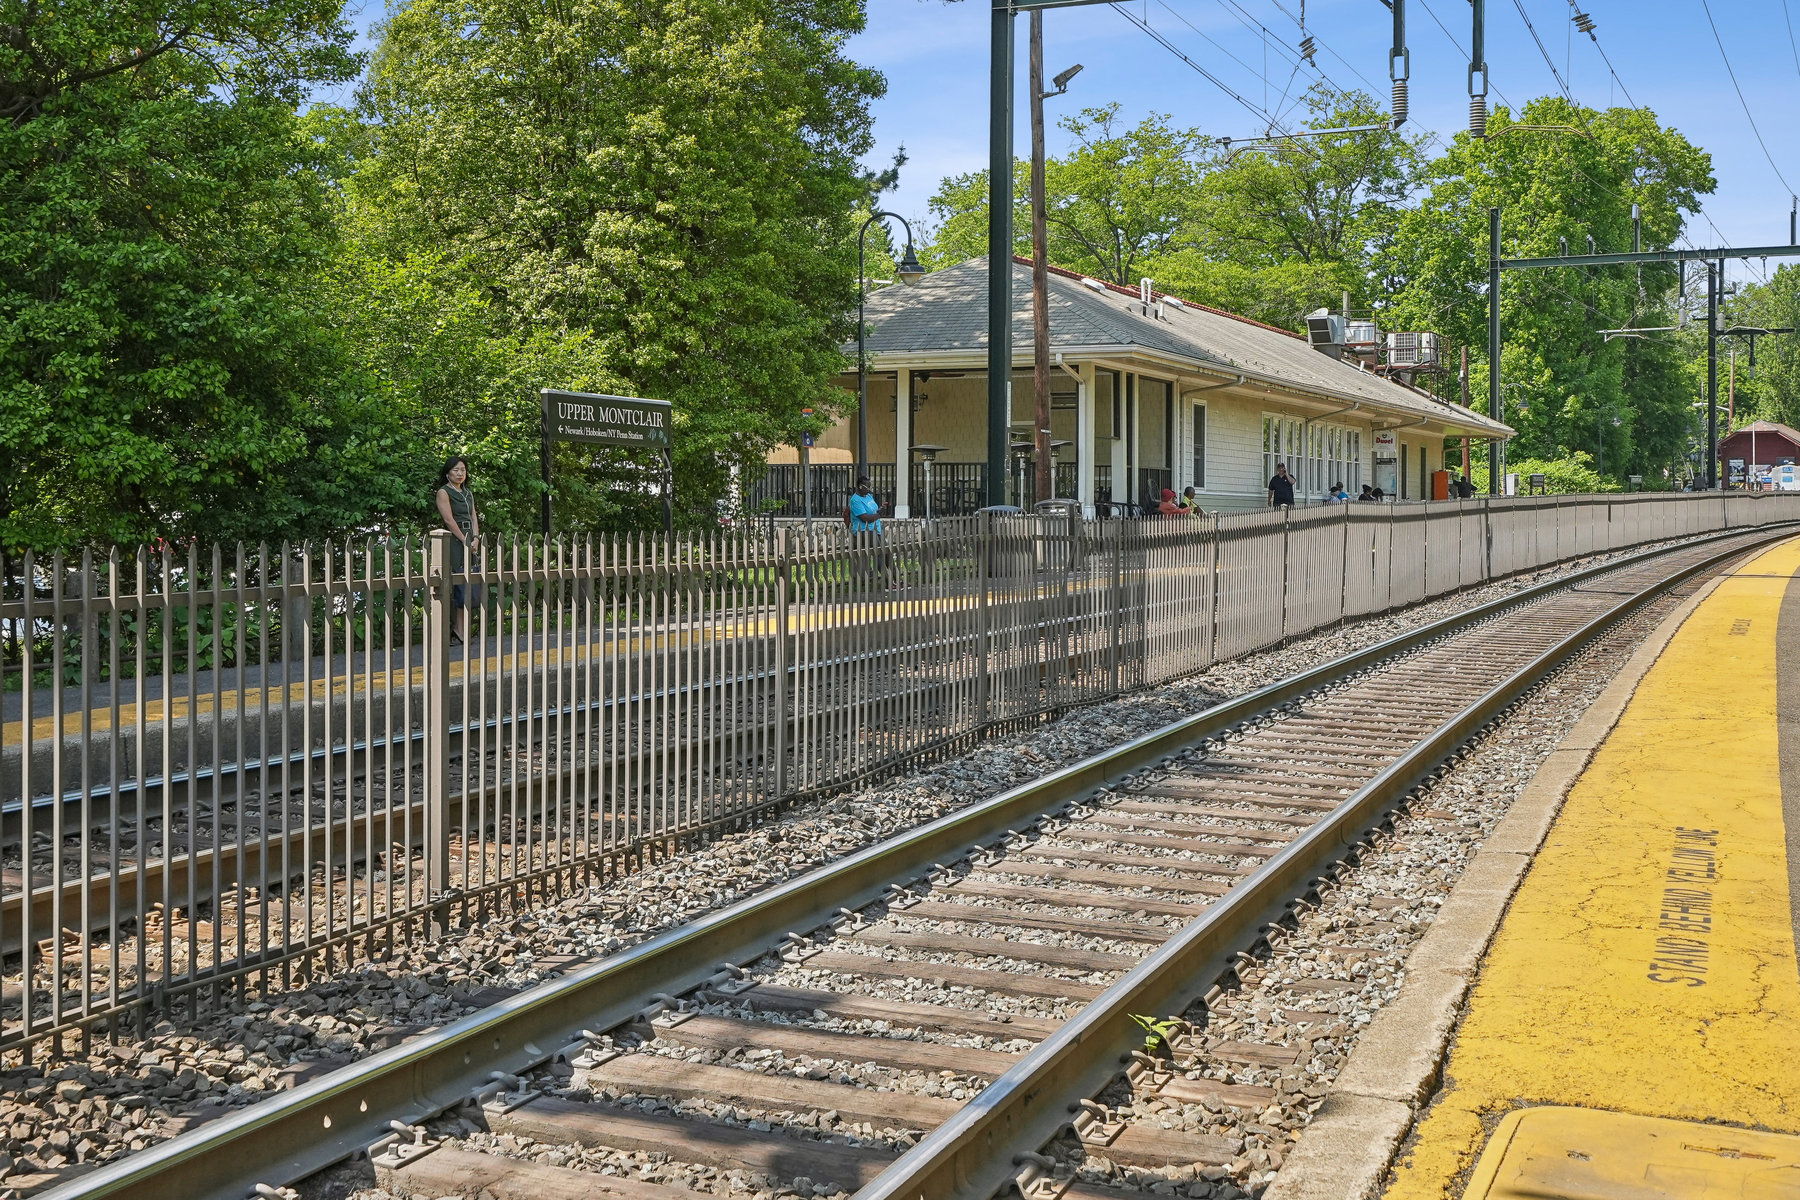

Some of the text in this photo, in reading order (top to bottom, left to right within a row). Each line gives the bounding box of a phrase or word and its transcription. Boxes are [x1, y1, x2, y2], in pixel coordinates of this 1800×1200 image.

[558, 402, 664, 428] UPPER MONTCLAIR
[1666, 846, 1717, 884] YELLOW
[1658, 888, 1713, 933] BEHIND
[1647, 937, 1710, 987] STAND
